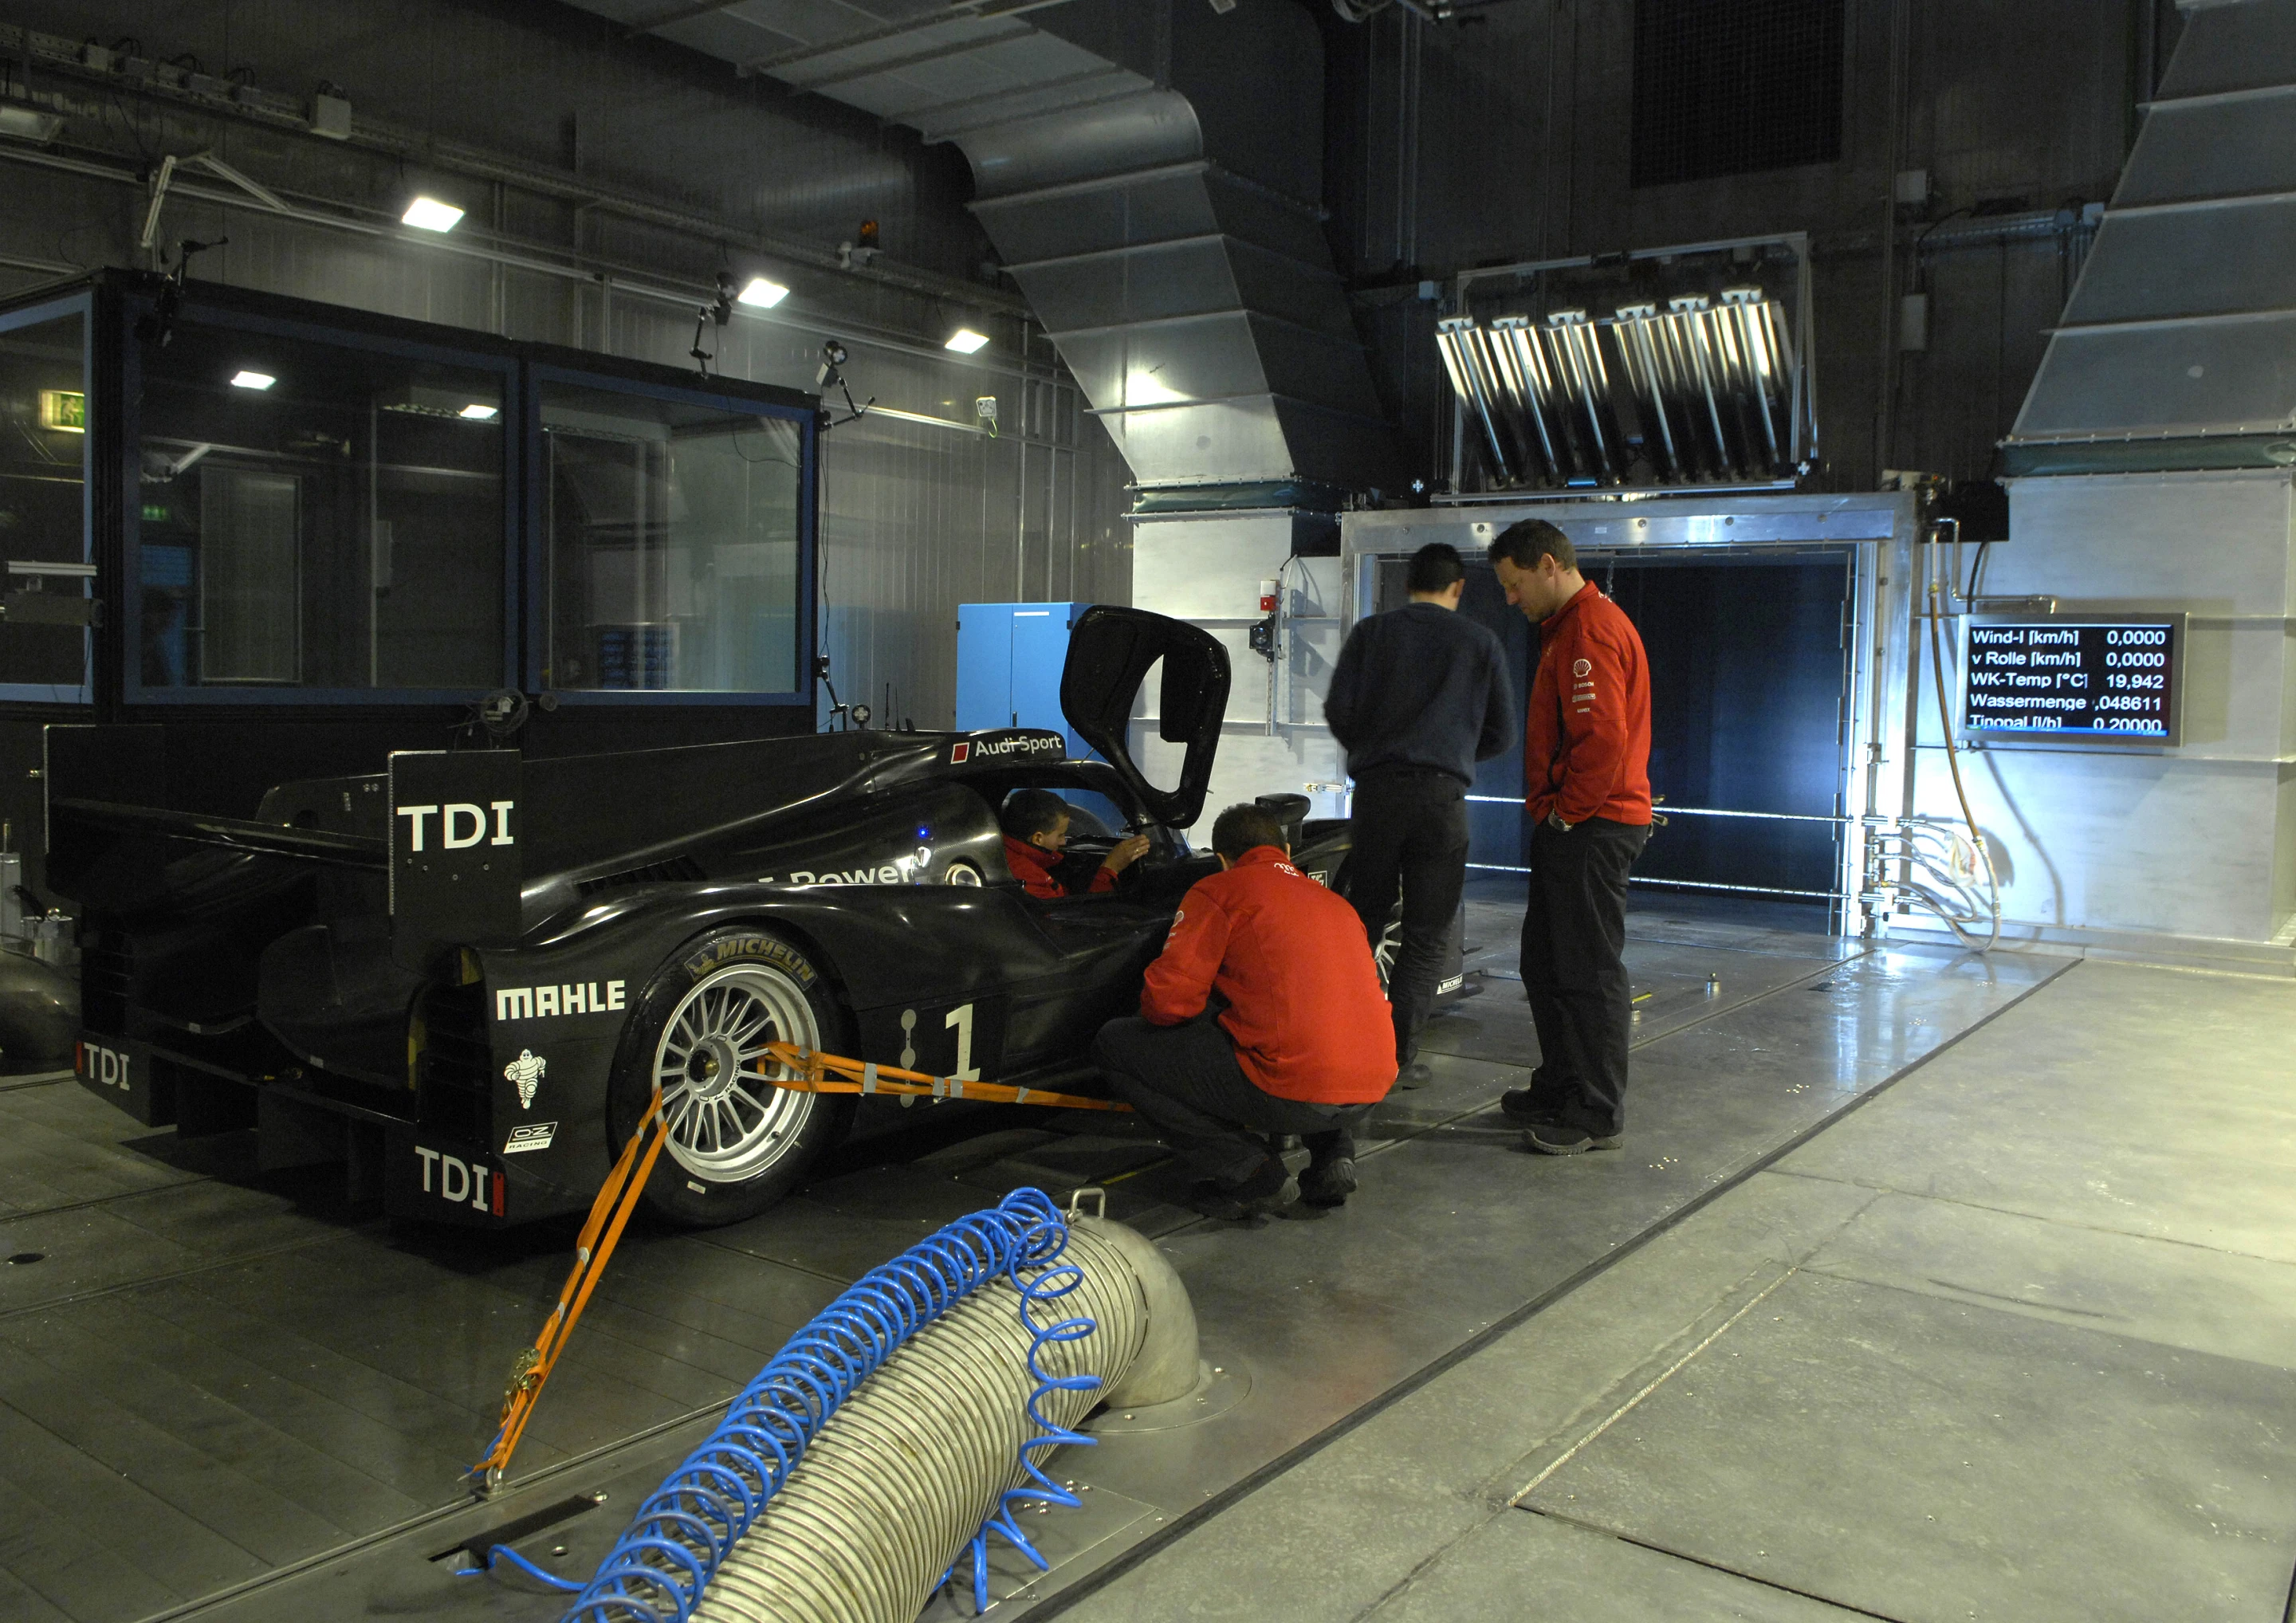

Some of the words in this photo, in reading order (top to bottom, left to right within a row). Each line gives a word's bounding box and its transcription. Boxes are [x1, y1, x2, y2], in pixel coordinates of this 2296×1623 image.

[2029, 631, 2079, 646] [km/h]
[2107, 631, 2166, 646] 0,0000
[1972, 654, 1982, 665] v
[1986, 652, 2026, 665] Rolle
[2031, 652, 2081, 668] [km/h]
[2105, 652, 2164, 669] 0,0000
[1971, 673, 2051, 689] WK-Temp
[2106, 674, 2164, 690] 19,942
[1970, 694, 2086, 710] Wassermenge
[975, 737, 1015, 756] Audi
[1019, 735, 1062, 754] Sport
[397, 801, 514, 851] TDI
[718, 938, 815, 982] MICHELIN
[497, 980, 625, 1020] MAHLE
[945, 1004, 981, 1082] 1
[84, 1042, 130, 1091] TDI
[509, 1140, 548, 1149] RACING
[415, 1146, 488, 1212] TDI
